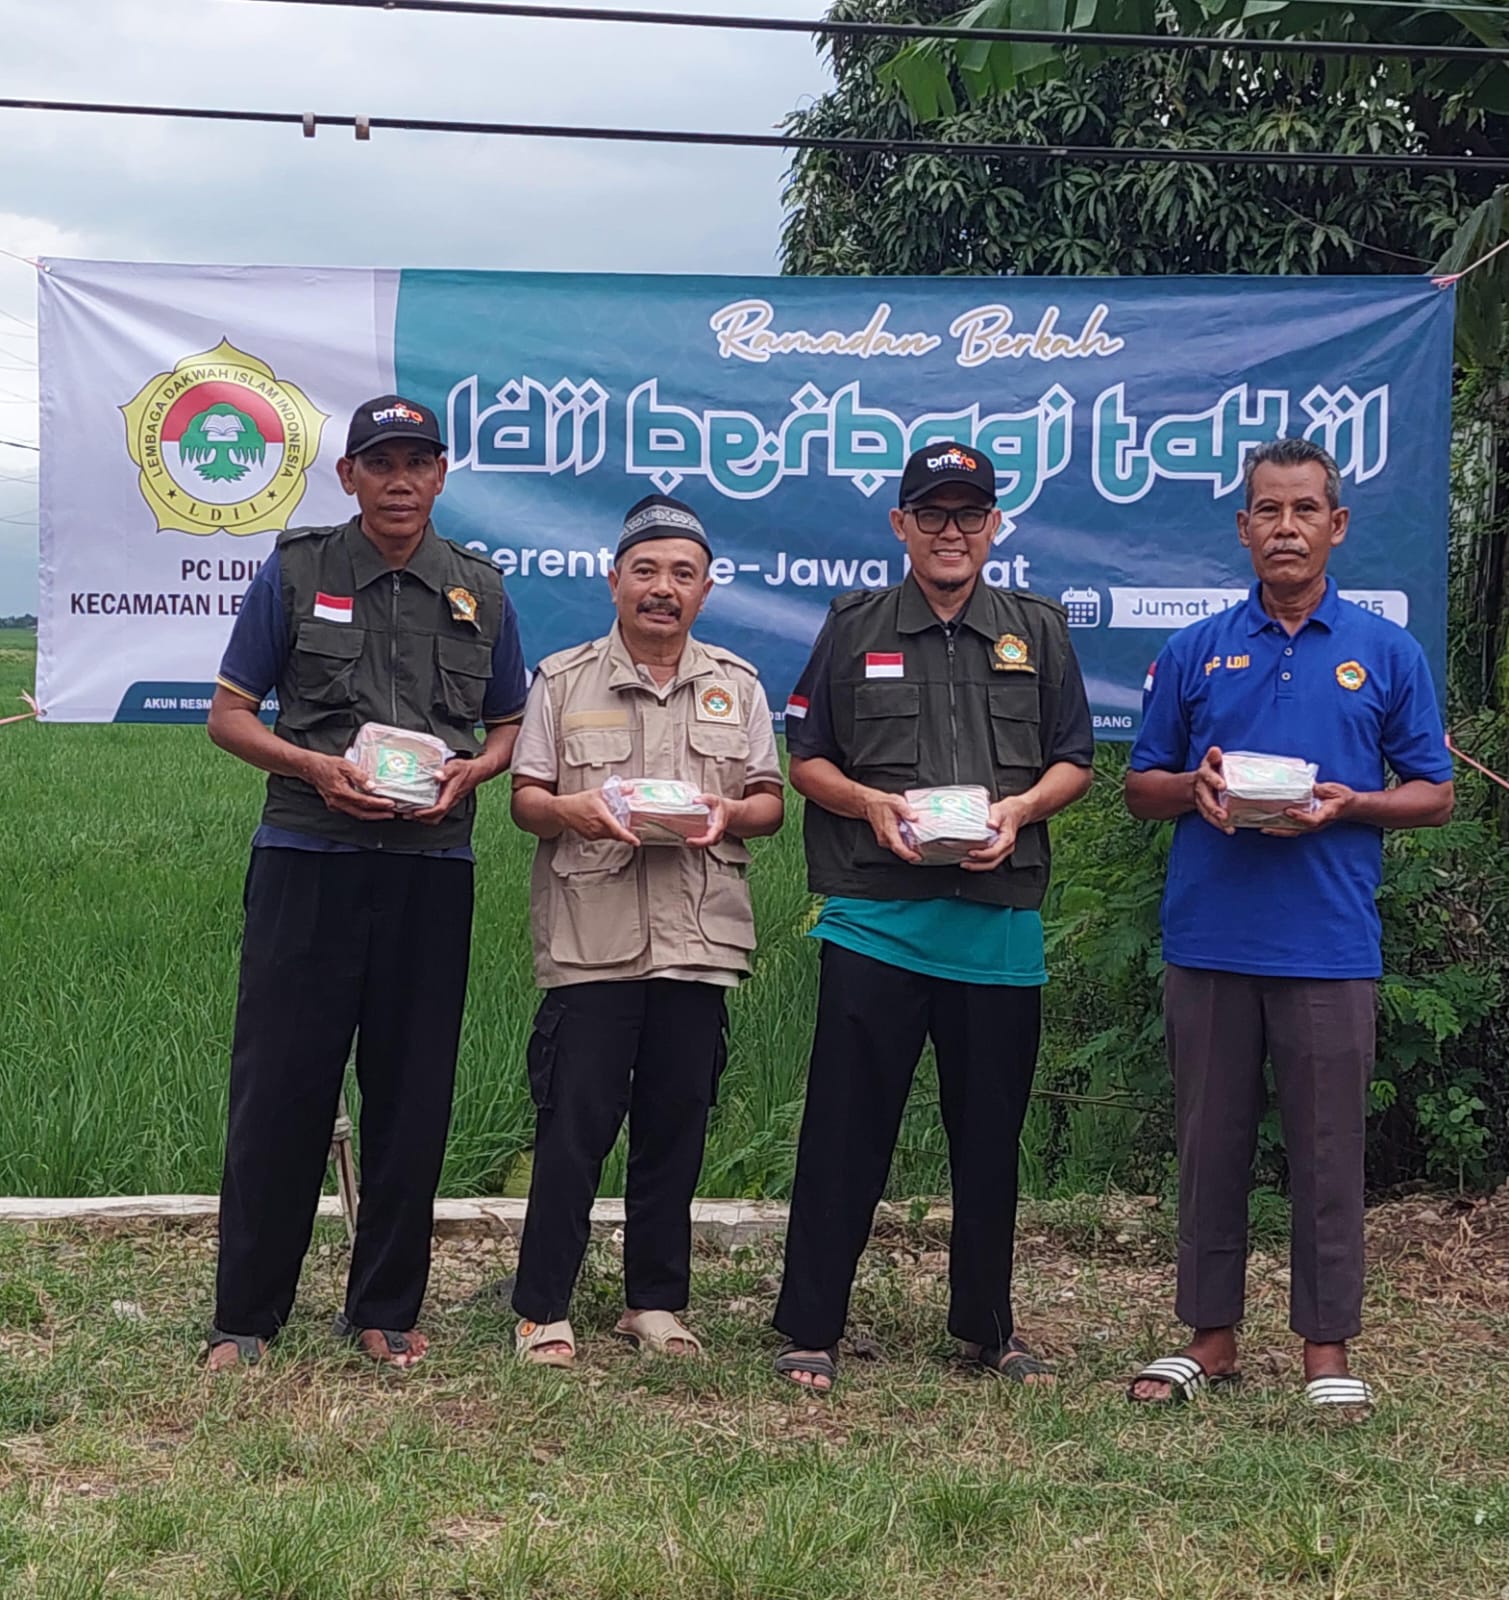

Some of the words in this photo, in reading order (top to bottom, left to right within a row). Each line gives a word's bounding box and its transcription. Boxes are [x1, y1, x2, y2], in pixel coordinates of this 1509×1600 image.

[710, 300, 941, 362] Ramadan
[949, 304, 1125, 367] Berkah
[144, 401, 165, 478] LEMBAGA
[163, 368, 228, 400] DAKWAH
[233, 370, 279, 399] ISLAM
[275, 398, 300, 478] INDONESIA
[181, 559, 212, 581] PC
[71, 593, 210, 616] KECAMATAN
[1205, 655, 1221, 676] PC
[1226, 654, 1250, 669] LDII
[143, 698, 177, 709] AKUN
